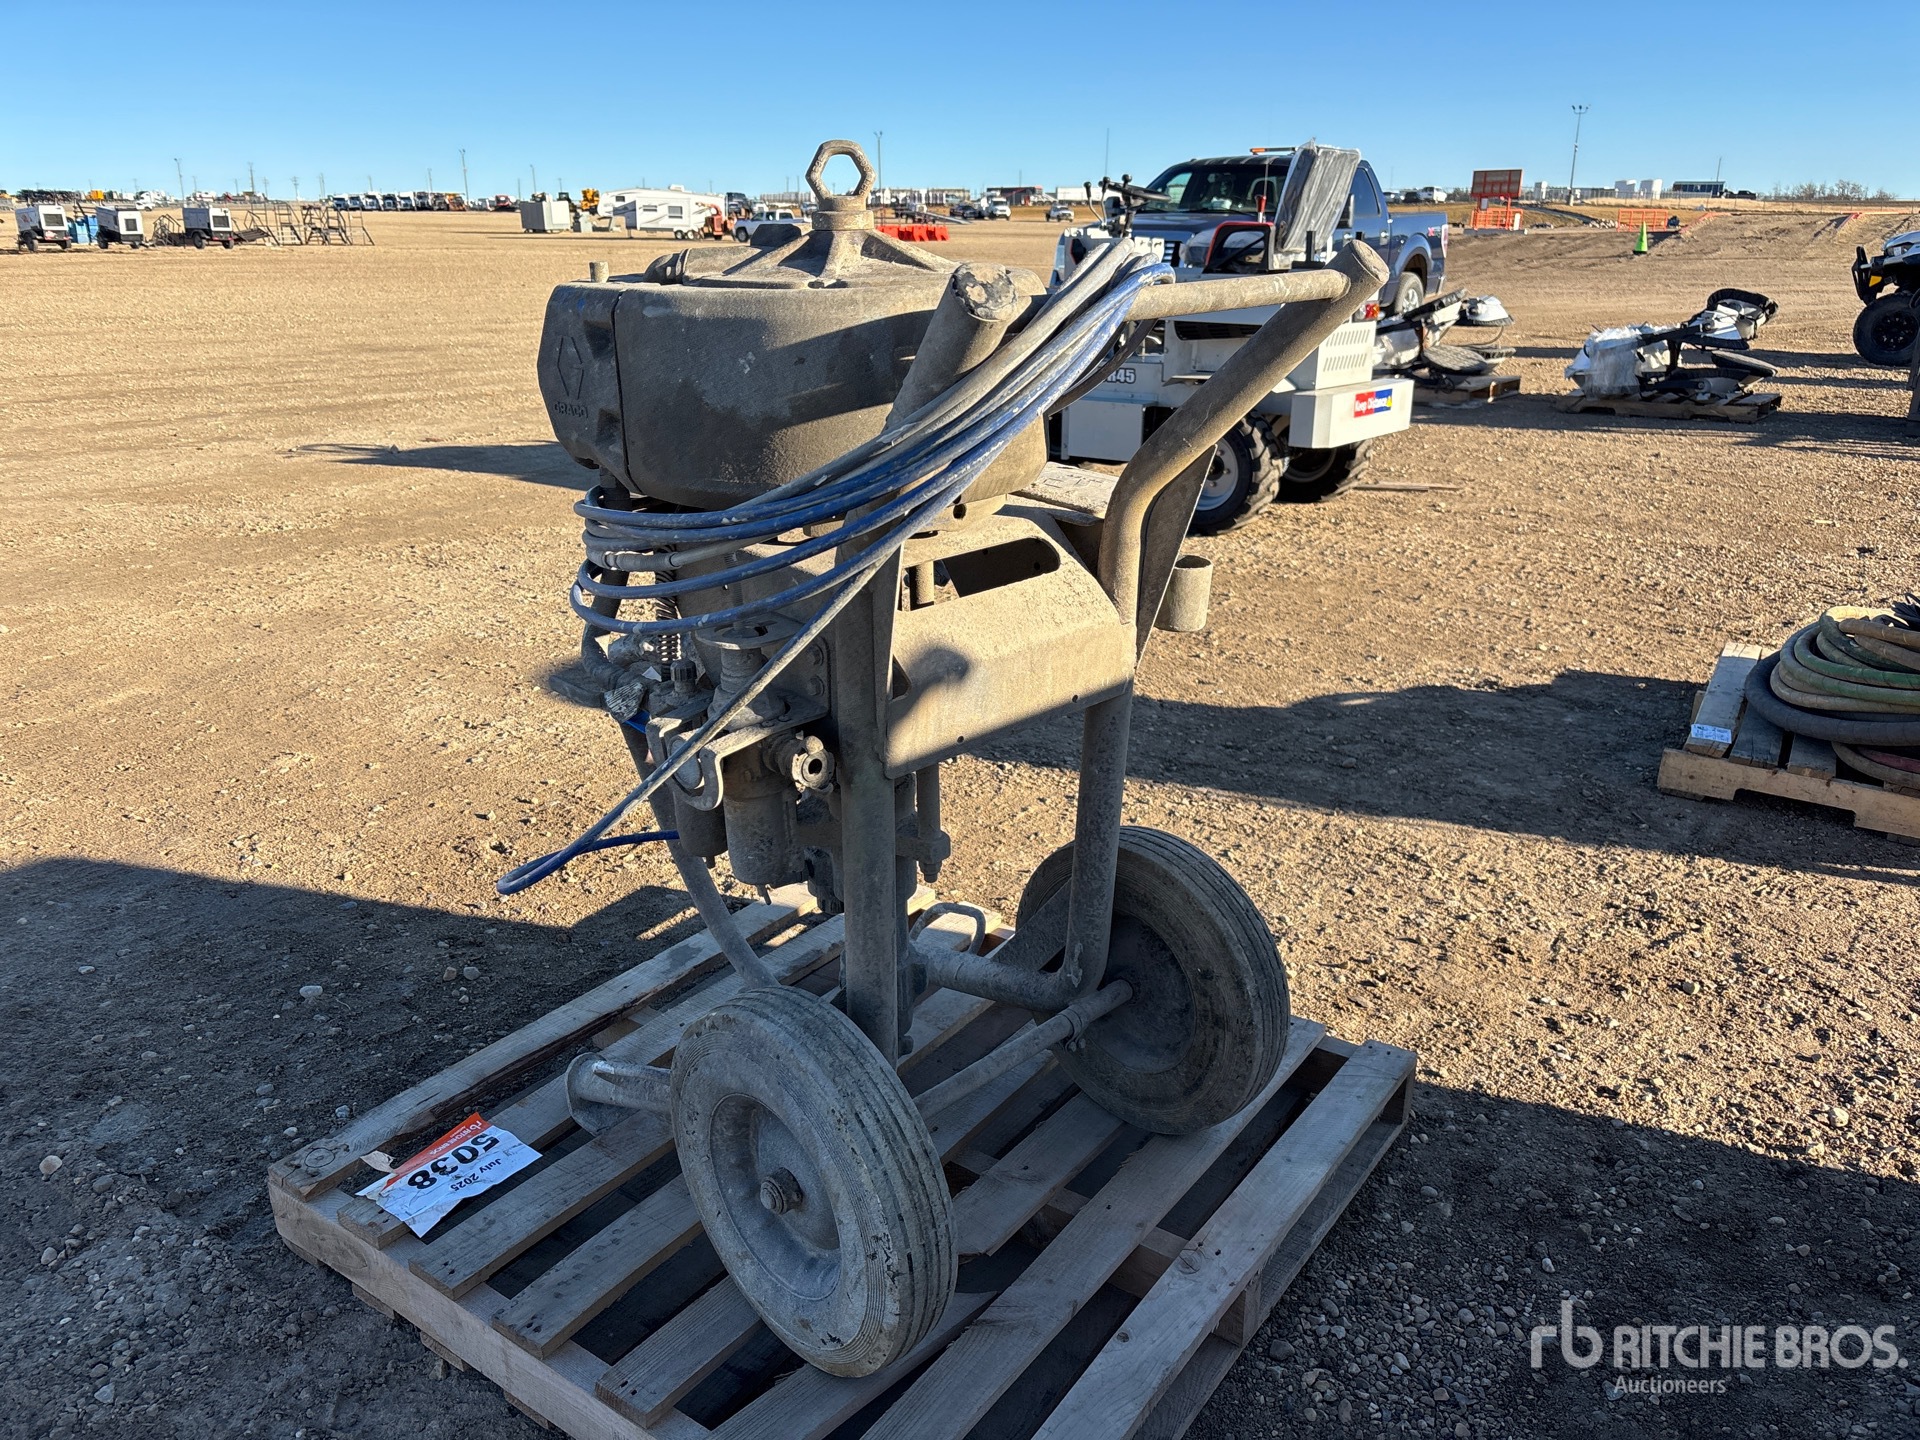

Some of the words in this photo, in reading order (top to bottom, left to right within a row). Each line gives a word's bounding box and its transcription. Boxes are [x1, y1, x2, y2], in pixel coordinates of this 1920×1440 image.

[407, 1133, 500, 1190] 5038
[479, 1158, 501, 1174] July
[450, 1175, 480, 1192] 2025
